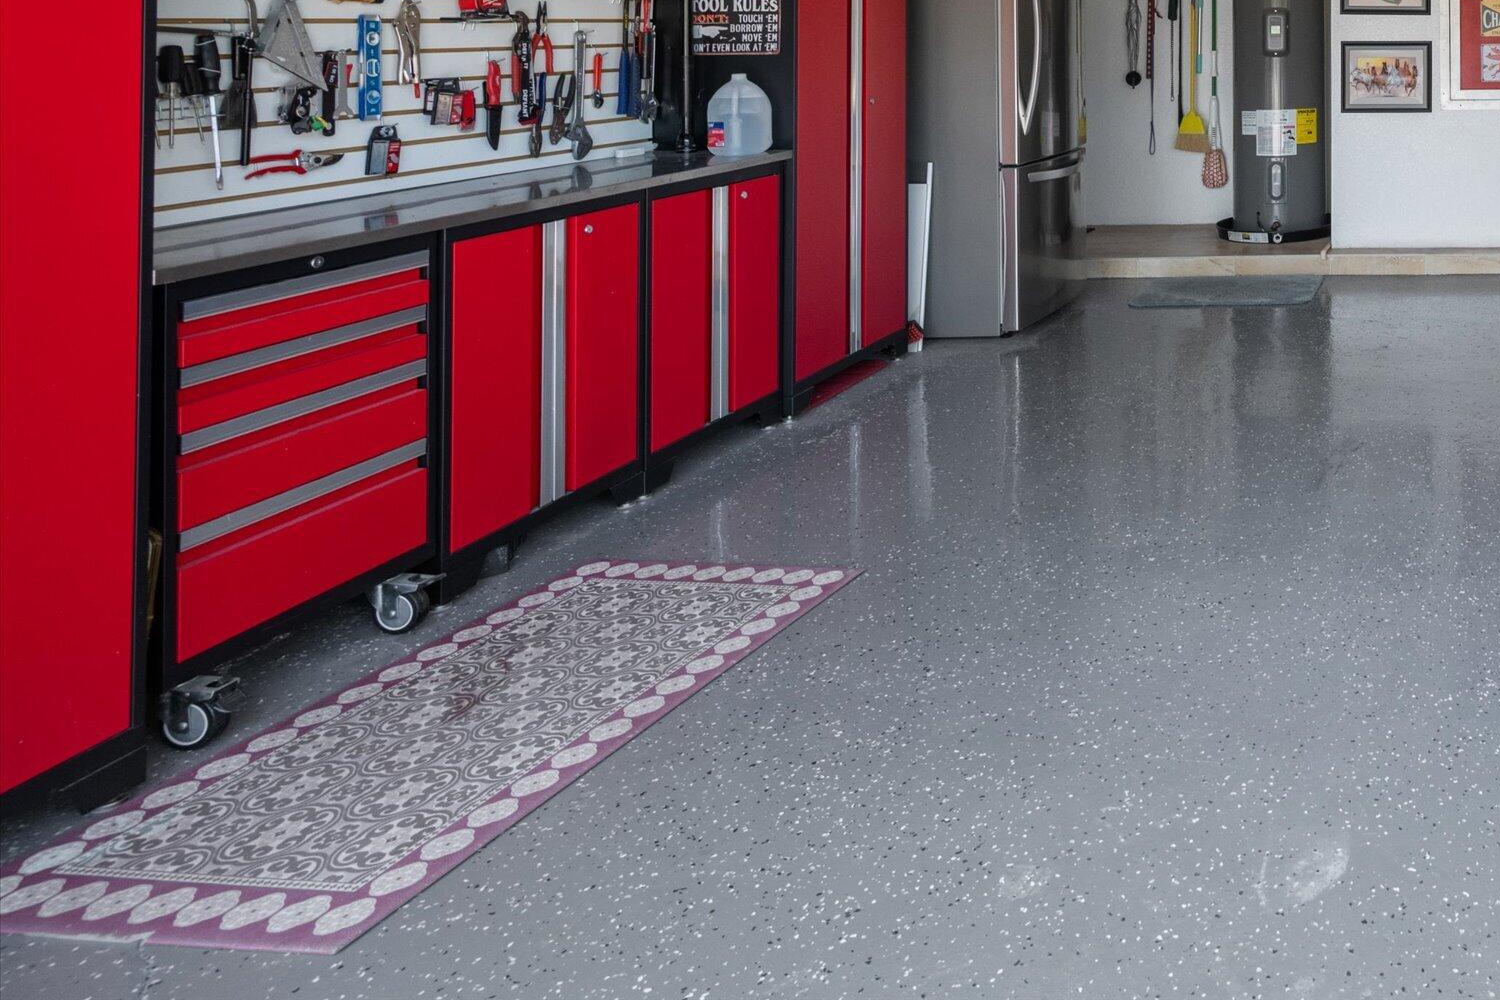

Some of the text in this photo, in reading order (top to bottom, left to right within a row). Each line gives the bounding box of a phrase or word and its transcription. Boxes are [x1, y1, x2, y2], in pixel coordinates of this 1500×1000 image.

[738, 14, 764, 23] TOUCH
[730, 24, 763, 32] BORROW
[742, 33, 762, 42] MOVE
[712, 43, 730, 52] EVEN
[732, 43, 750, 52] LOOK
[752, 43, 762, 52] AT
